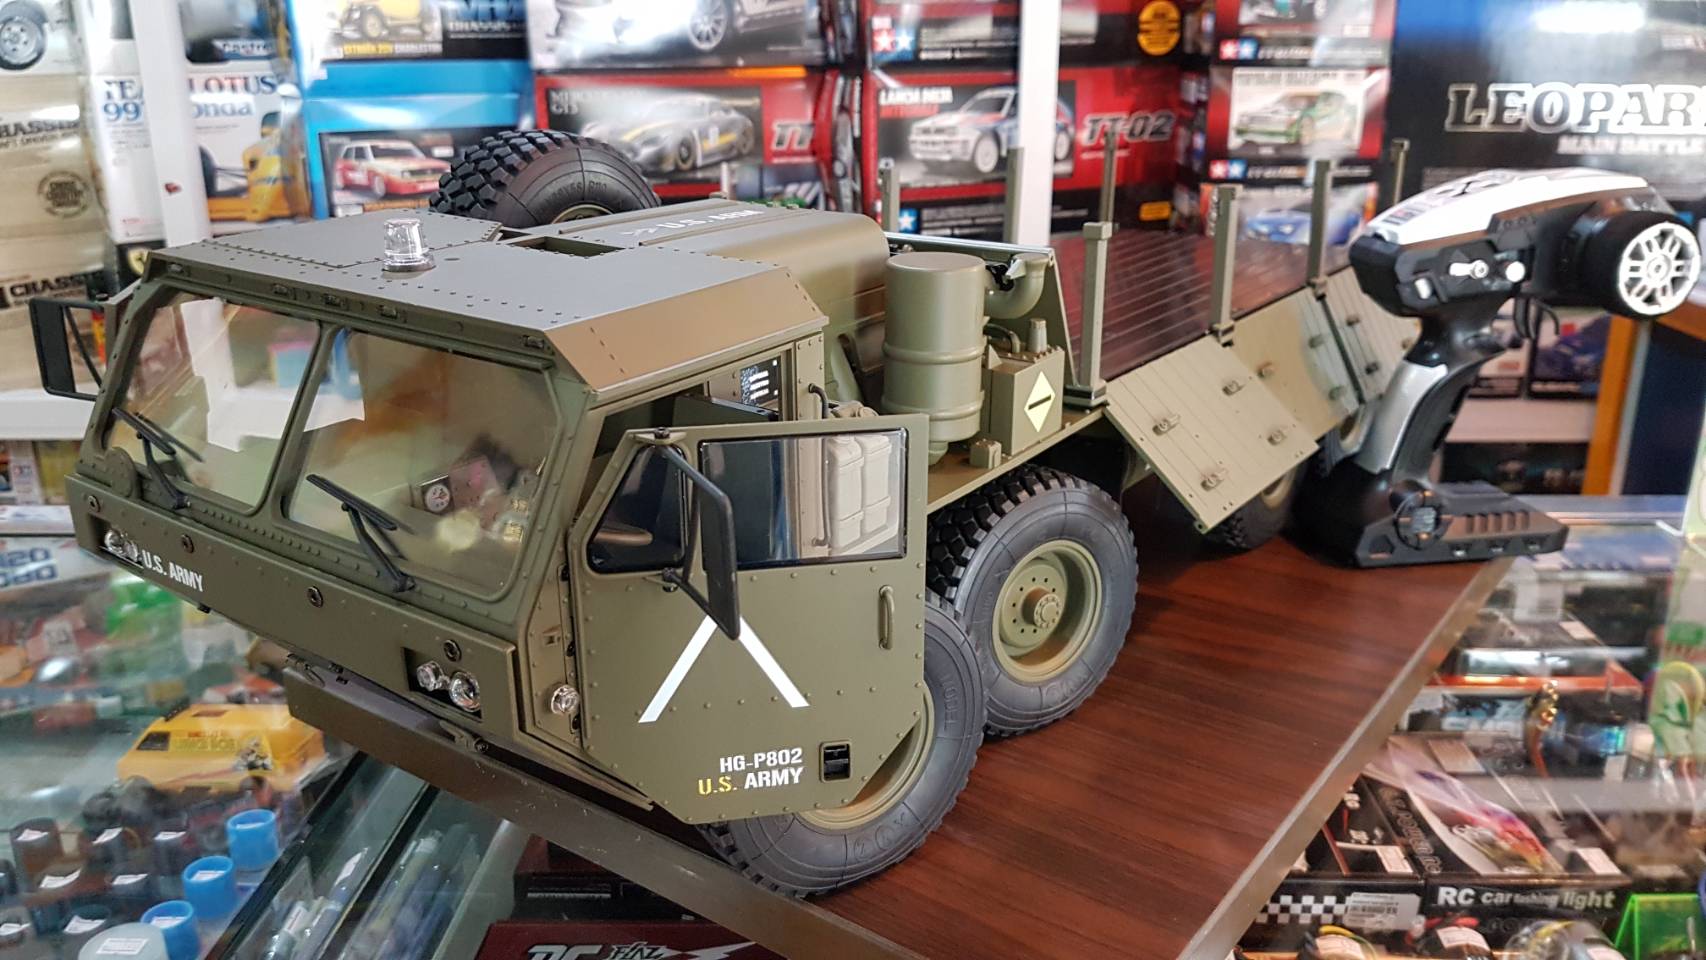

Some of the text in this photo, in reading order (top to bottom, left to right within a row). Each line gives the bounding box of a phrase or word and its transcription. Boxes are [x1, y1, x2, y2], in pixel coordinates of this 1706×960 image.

[103, 101, 145, 122] 99
[1444, 82, 1706, 134] LEOPAR
[1556, 136, 1616, 155] MAIN
[142, 549, 204, 592] U.S. ARMY
[719, 747, 803, 773] HG-P802
[698, 767, 804, 795] U.S. ARMY
[1437, 886, 1475, 905] RC
[1481, 890, 1514, 905] car
[1561, 889, 1617, 911] light
